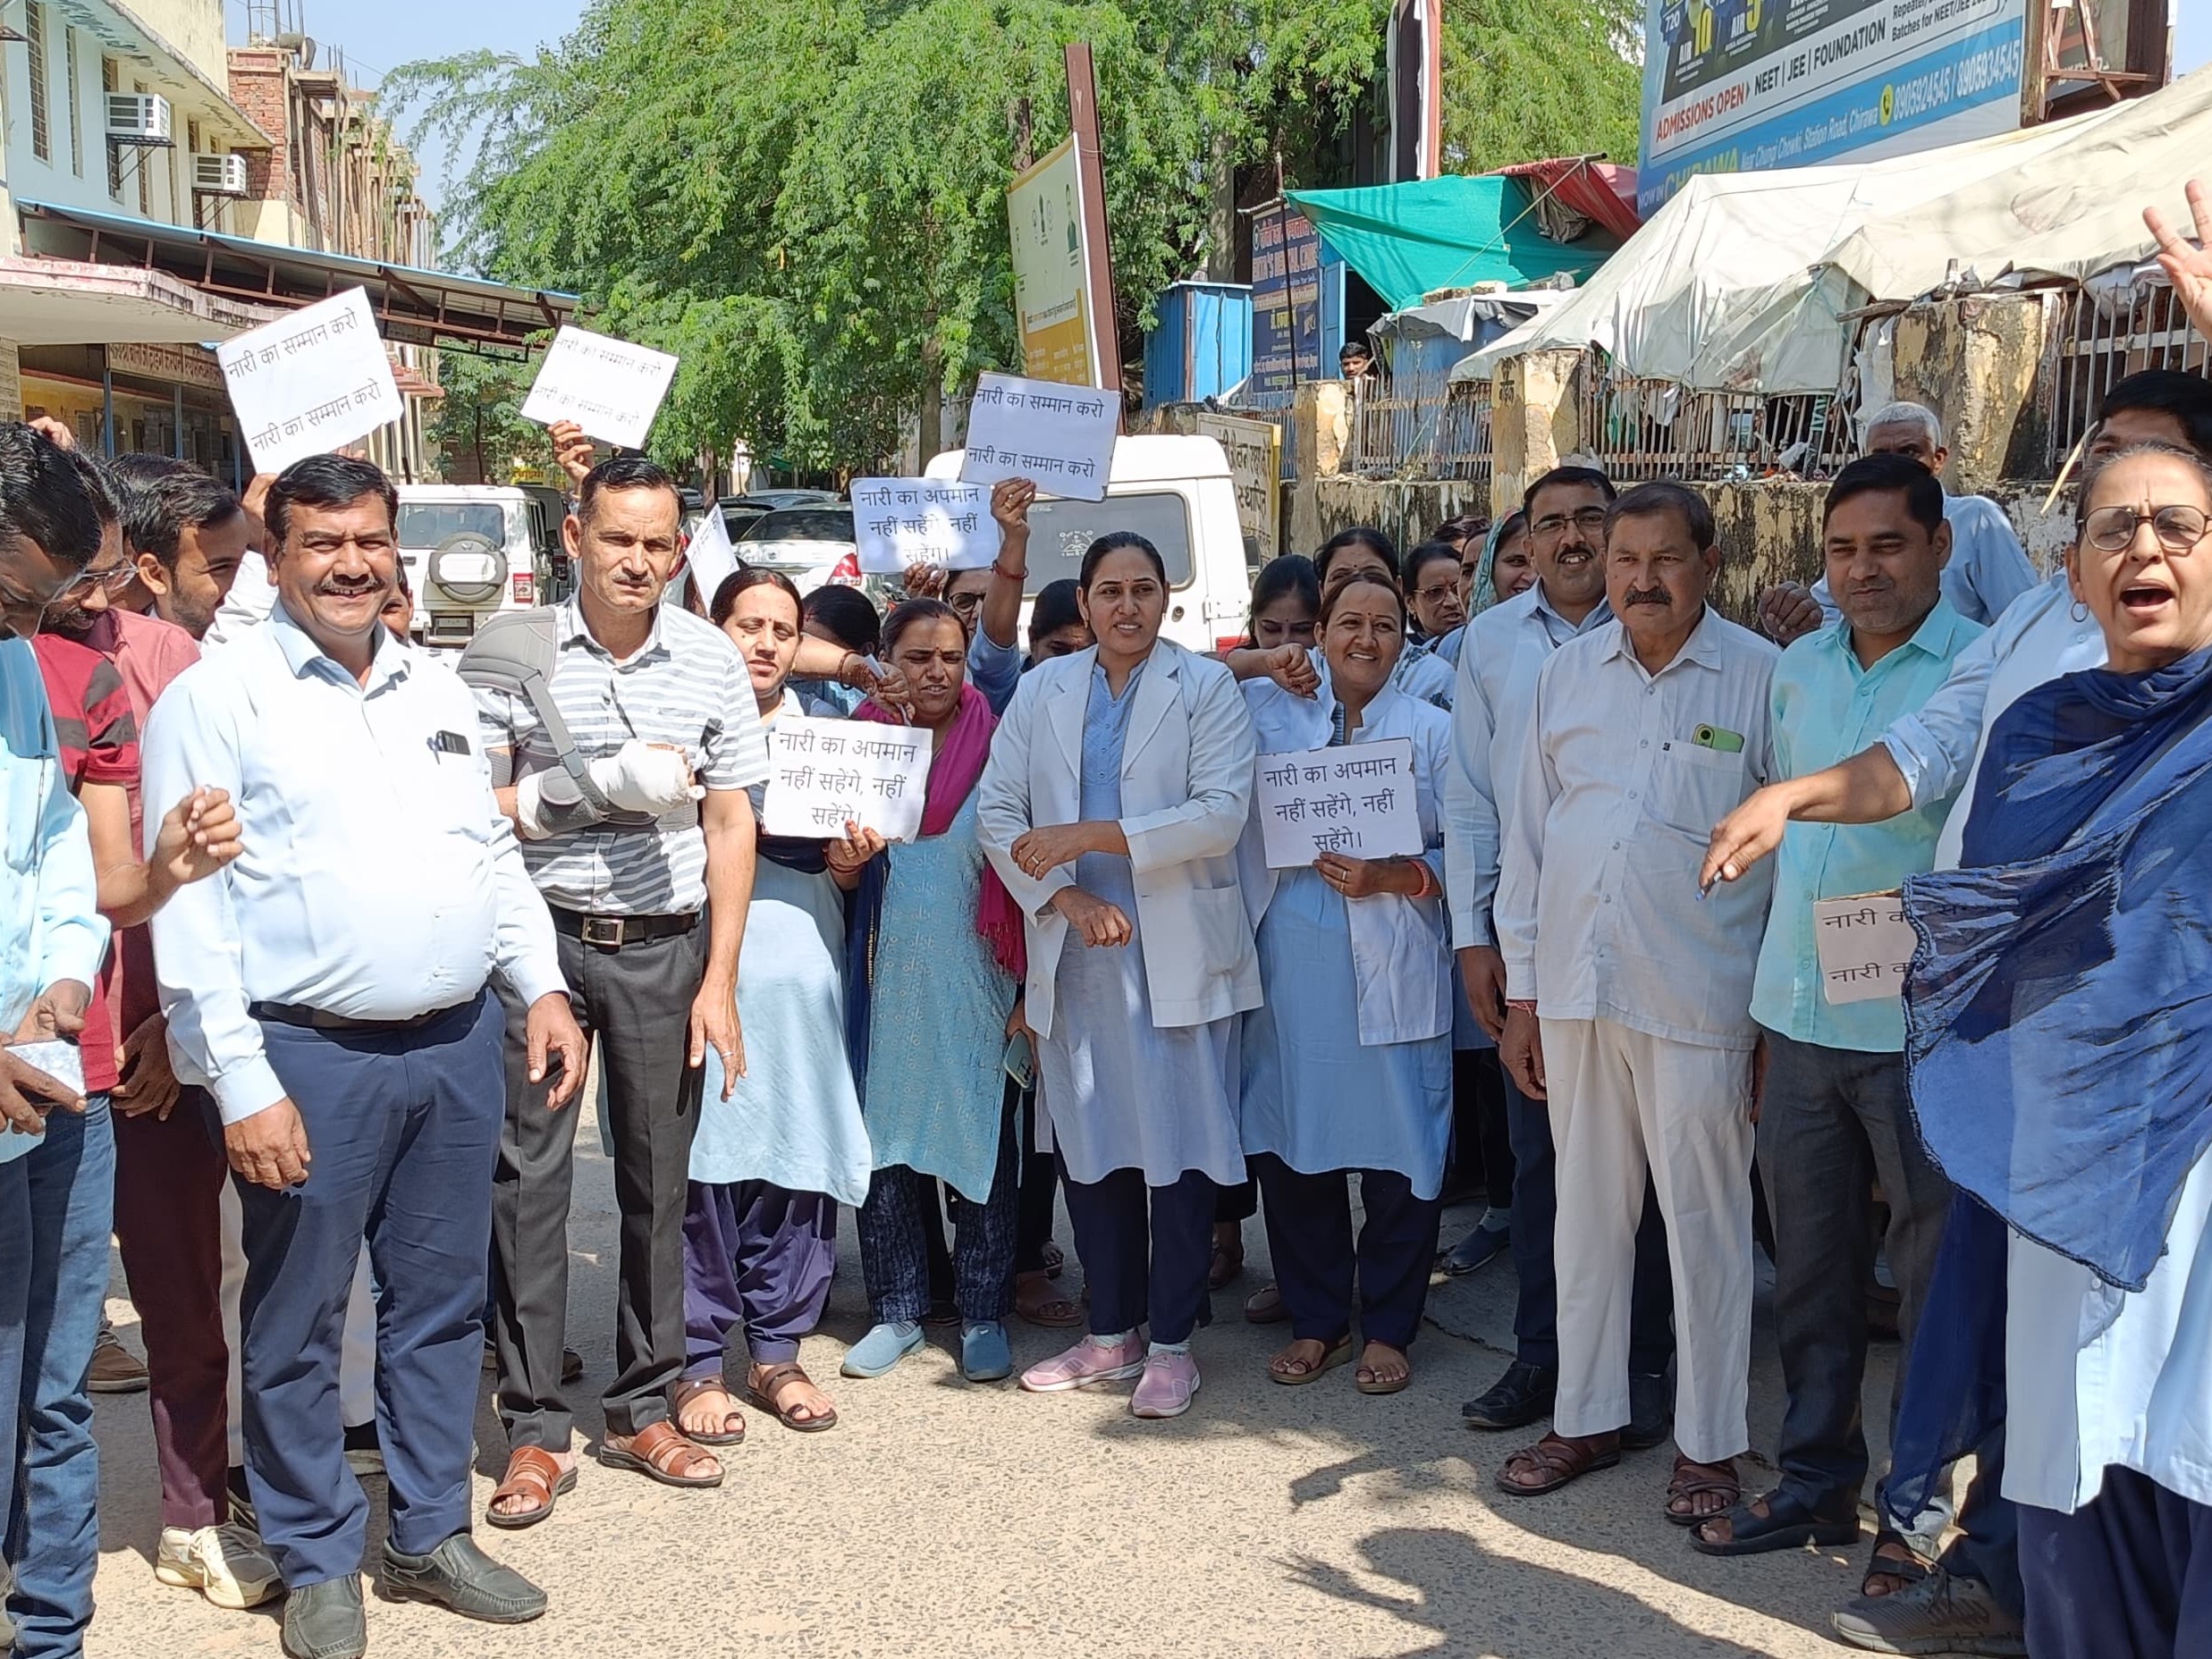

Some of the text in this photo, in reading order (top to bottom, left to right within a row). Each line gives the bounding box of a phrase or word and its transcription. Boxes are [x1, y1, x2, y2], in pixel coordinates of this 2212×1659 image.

[1665, 12, 1681, 34] 720
[1677, 41, 1692, 65] AIR
[1695, 8, 1711, 57] 10
[1731, 13, 1745, 39] AIR
[1893, 19, 1921, 41] Batches
[1922, 13, 1933, 29] for
[1656, 96, 1714, 143] ADMISSIONS
[1717, 81, 1743, 115] OPEN
[1754, 66, 1779, 97] NEET
[1787, 53, 1806, 82] JEE
[1813, 17, 1887, 70] FOUNDATION
[1638, 188, 1656, 209] NOW
[1656, 184, 1664, 202] IN
[1803, 123, 1828, 150] Station
[1849, 105, 1878, 133] Chirawa
[1894, 66, 1951, 122] 8905924545
[1957, 39, 2021, 97] 8905934545
[226, 350, 258, 379] नारी
[259, 345, 280, 365] का
[283, 324, 328, 355] सम्मान
[330, 307, 358, 334] करो
[556, 337, 579, 352] नारी
[580, 345, 597, 358] का
[535, 385, 558, 400] नारी
[977, 386, 1104, 418] नारी का सम्मान करो
[251, 377, 381, 451] नारी का सम्मान करो
[968, 445, 1094, 477] नारी का सम्मान करो
[860, 487, 979, 506] नारी का अपमान
[869, 516, 899, 536] नहीं
[949, 512, 978, 533] नहीं
[780, 729, 918, 762] नारी का अपमान
[781, 766, 908, 799] नहीं सहेंगे, नहीं
[1263, 758, 1397, 787] नारी का अपमान
[1274, 787, 1395, 822] नहीं सहेंगे, नहीं
[1313, 826, 1363, 852] सहेंगे।
[1822, 908, 1878, 928] नारी
[1829, 963, 1882, 982] नारी
